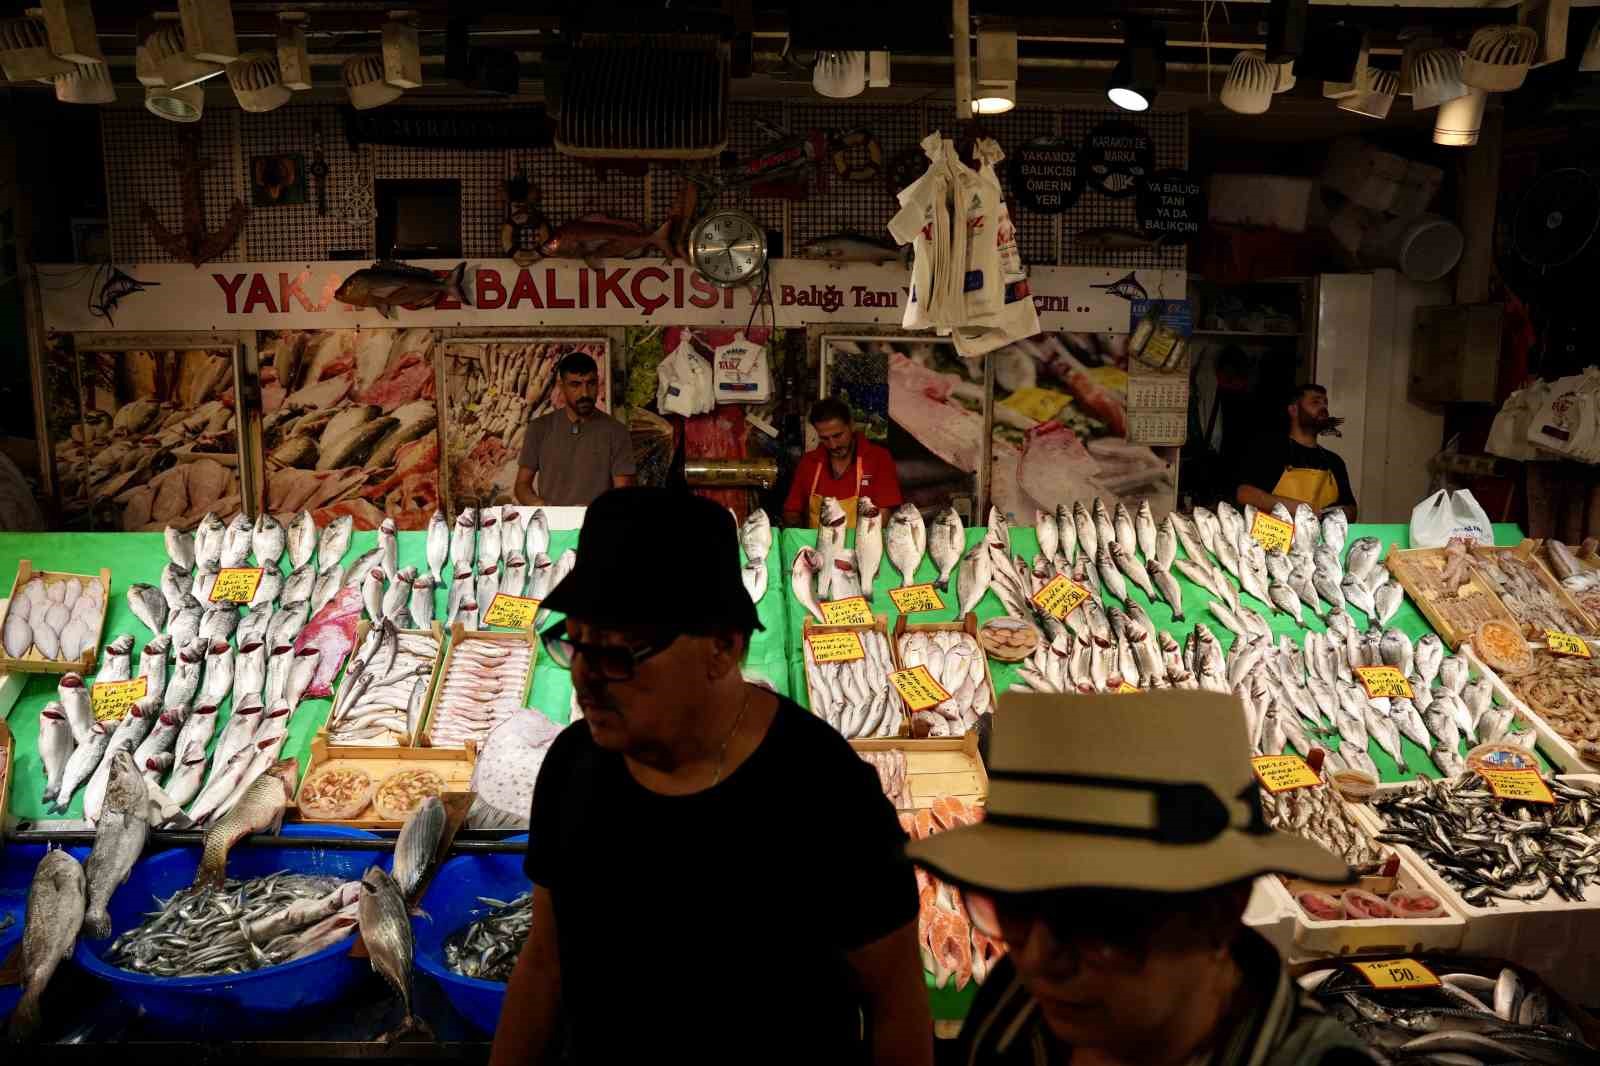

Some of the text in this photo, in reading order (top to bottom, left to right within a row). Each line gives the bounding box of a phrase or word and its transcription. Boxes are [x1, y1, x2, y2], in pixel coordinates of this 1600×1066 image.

[1022, 151, 1077, 162] YAKAMOZ
[1104, 151, 1136, 161] MARKA
[1148, 183, 1161, 192] YA
[1160, 195, 1185, 206] TANI
[1156, 208, 1188, 218] YA DA
[211, 268, 734, 315] YAKZ BALIKÇISI
[780, 285, 844, 312] Balığı
[851, 286, 897, 307] Tanı
